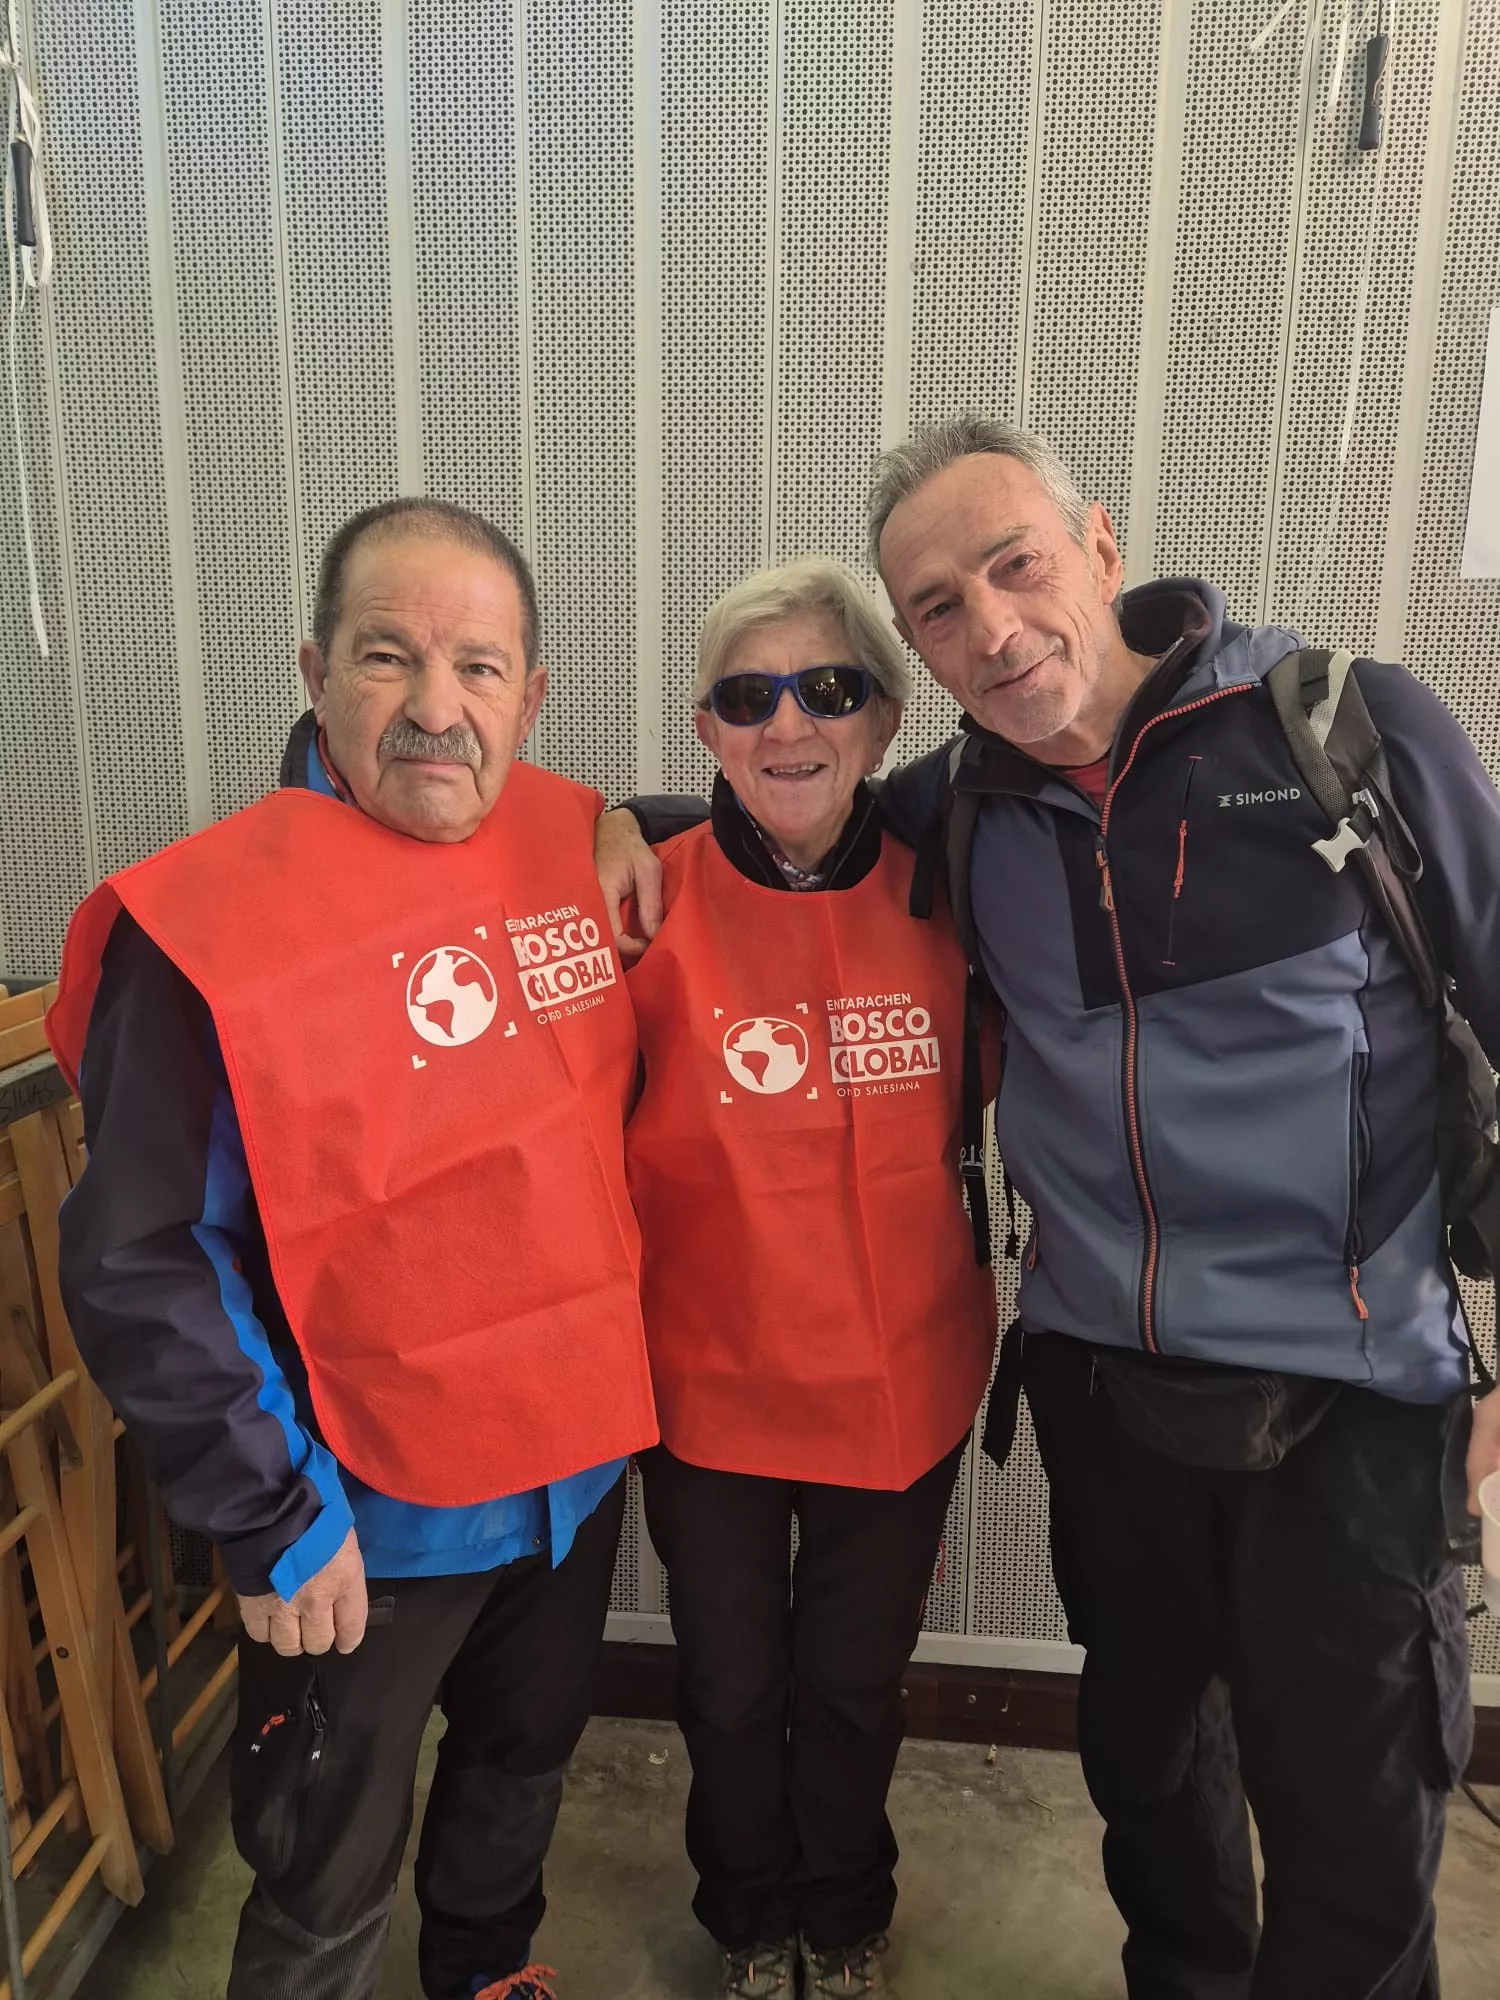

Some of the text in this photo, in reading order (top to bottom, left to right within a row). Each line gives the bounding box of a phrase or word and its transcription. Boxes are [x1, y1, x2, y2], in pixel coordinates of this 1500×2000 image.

[1236, 788, 1301, 805] SIMOND
[828, 1006, 931, 1043] BOSCO
[866, 1080, 921, 1096] SALESIANA
